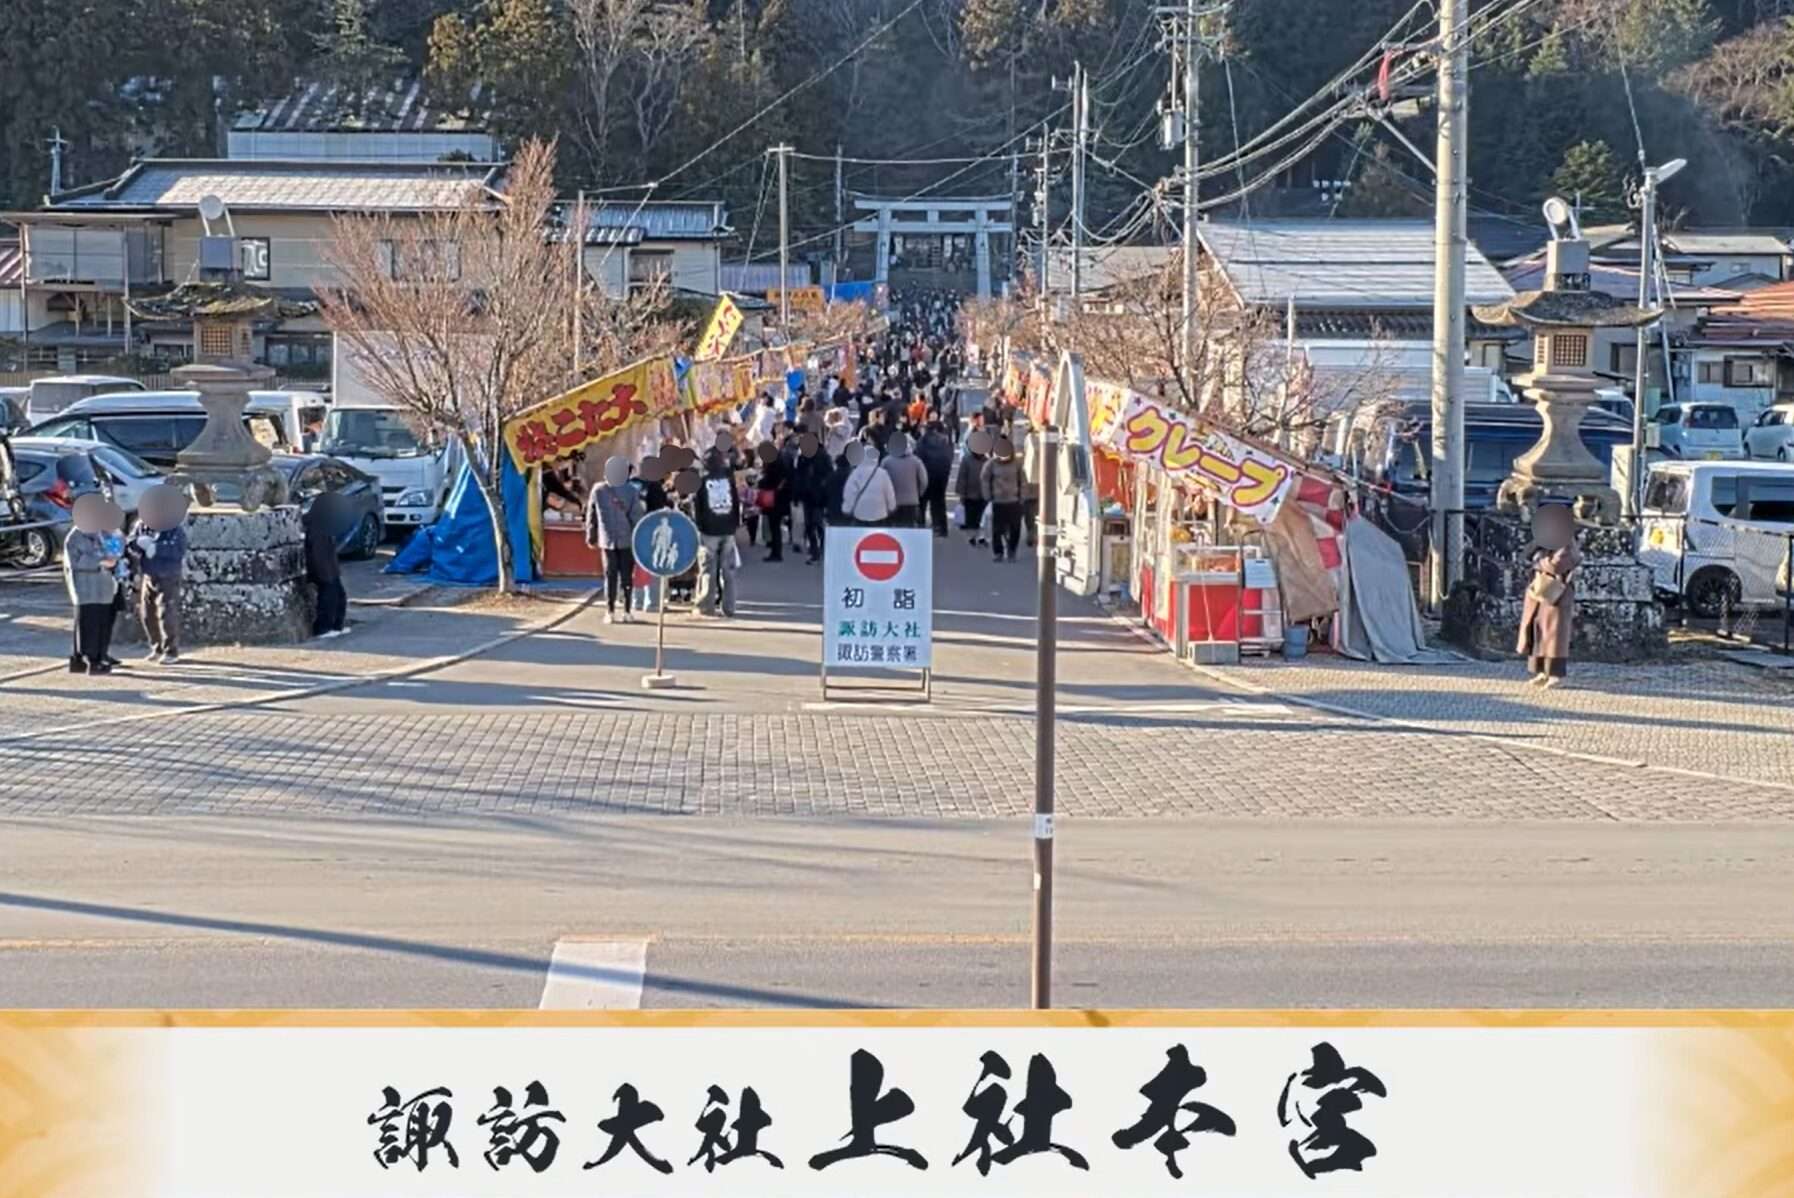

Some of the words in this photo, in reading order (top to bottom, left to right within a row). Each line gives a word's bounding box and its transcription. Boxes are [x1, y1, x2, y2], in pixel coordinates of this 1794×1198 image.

[1126, 406, 1288, 506] クレープ
[838, 620, 921, 638] 諏訪大社
[837, 643, 918, 662] 諏訪警察署
